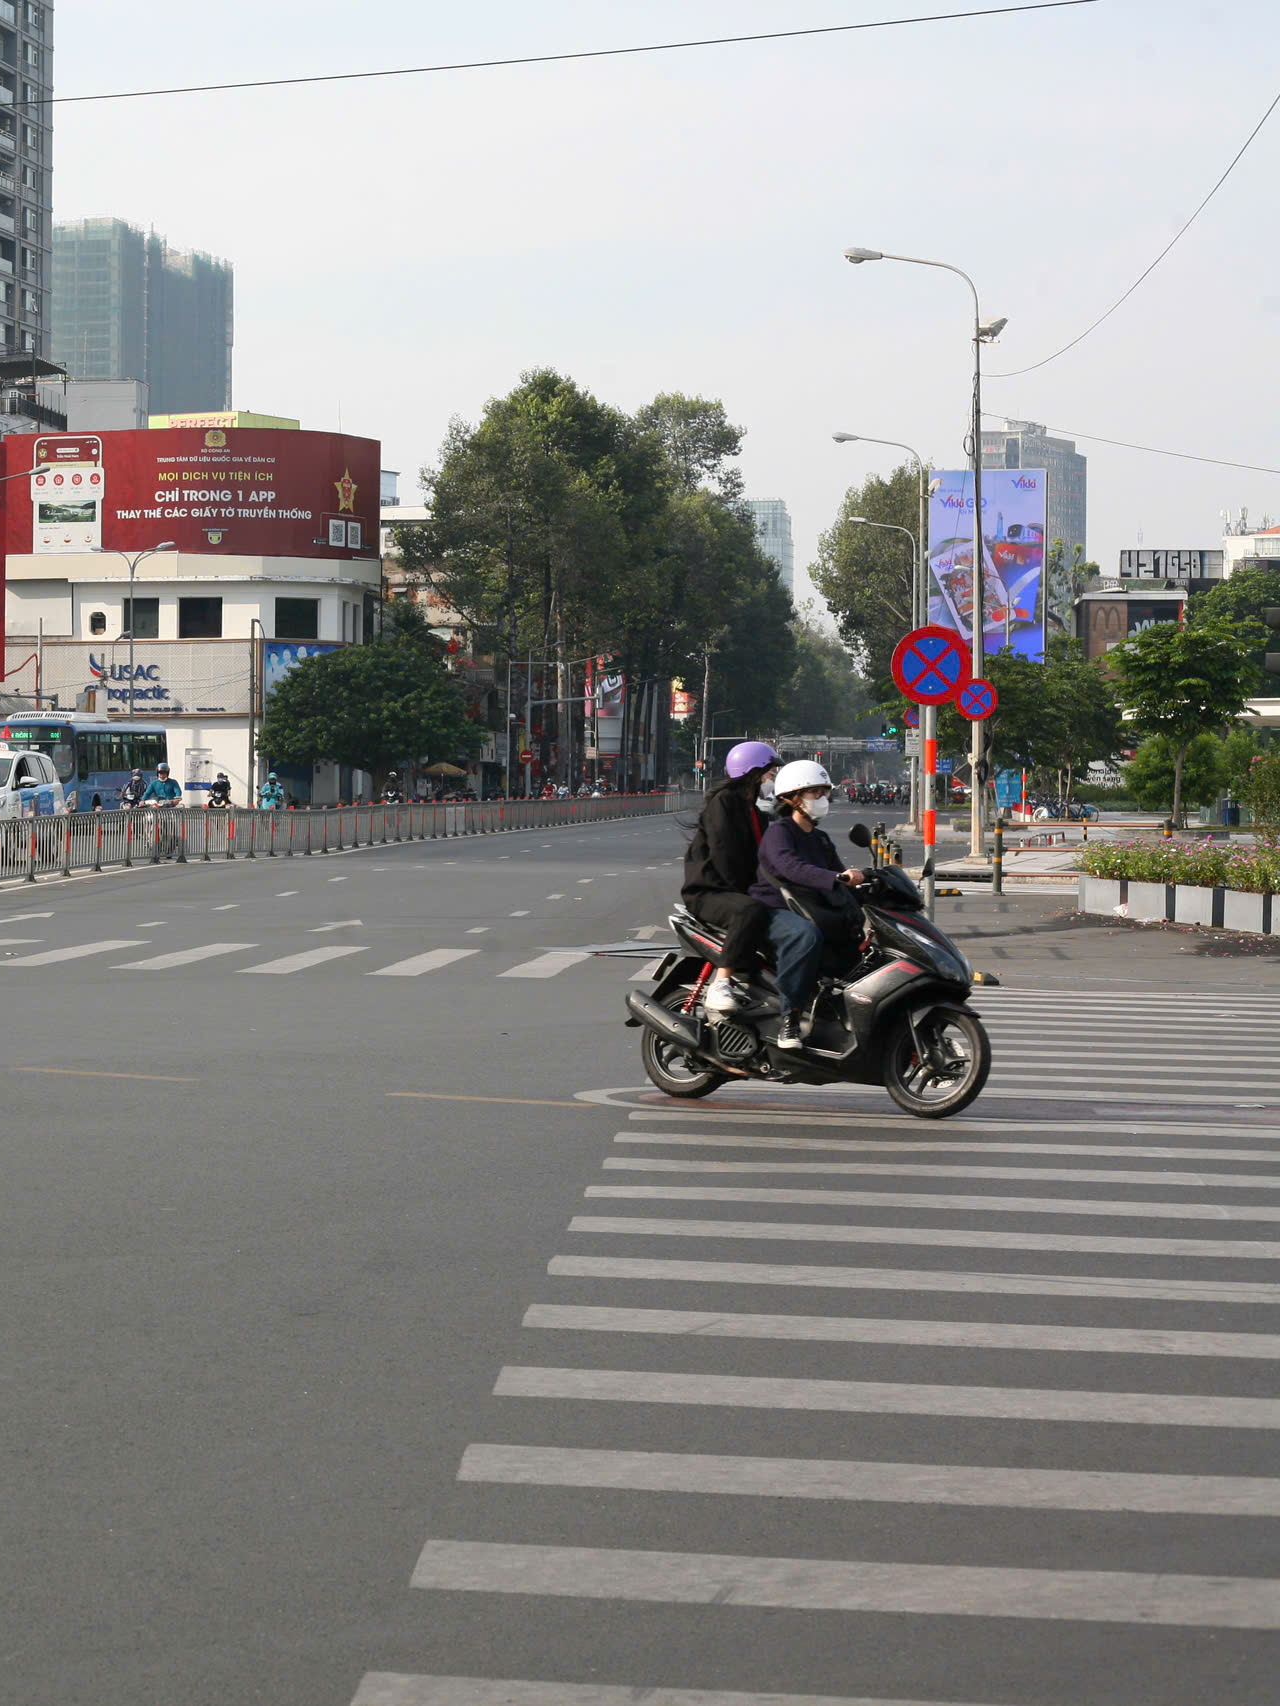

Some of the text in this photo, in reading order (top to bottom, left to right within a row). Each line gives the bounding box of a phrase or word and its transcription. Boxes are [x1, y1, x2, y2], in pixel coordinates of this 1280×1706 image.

[169, 416, 237, 428] PERFECT
[158, 471, 273, 483] MỌI DỊCH VỤ TIỆN ÍCH
[1011, 475, 1037, 489] Vikki
[154, 487, 276, 502] CHỈ TRONG 1 APP
[940, 494, 964, 508] Vikki
[116, 505, 312, 520] THAY THẾ CÁC GIẤY TỜ TRUYỀN THỐNG
[110, 664, 161, 681] USAC
[84, 684, 170, 704] Cropactic
